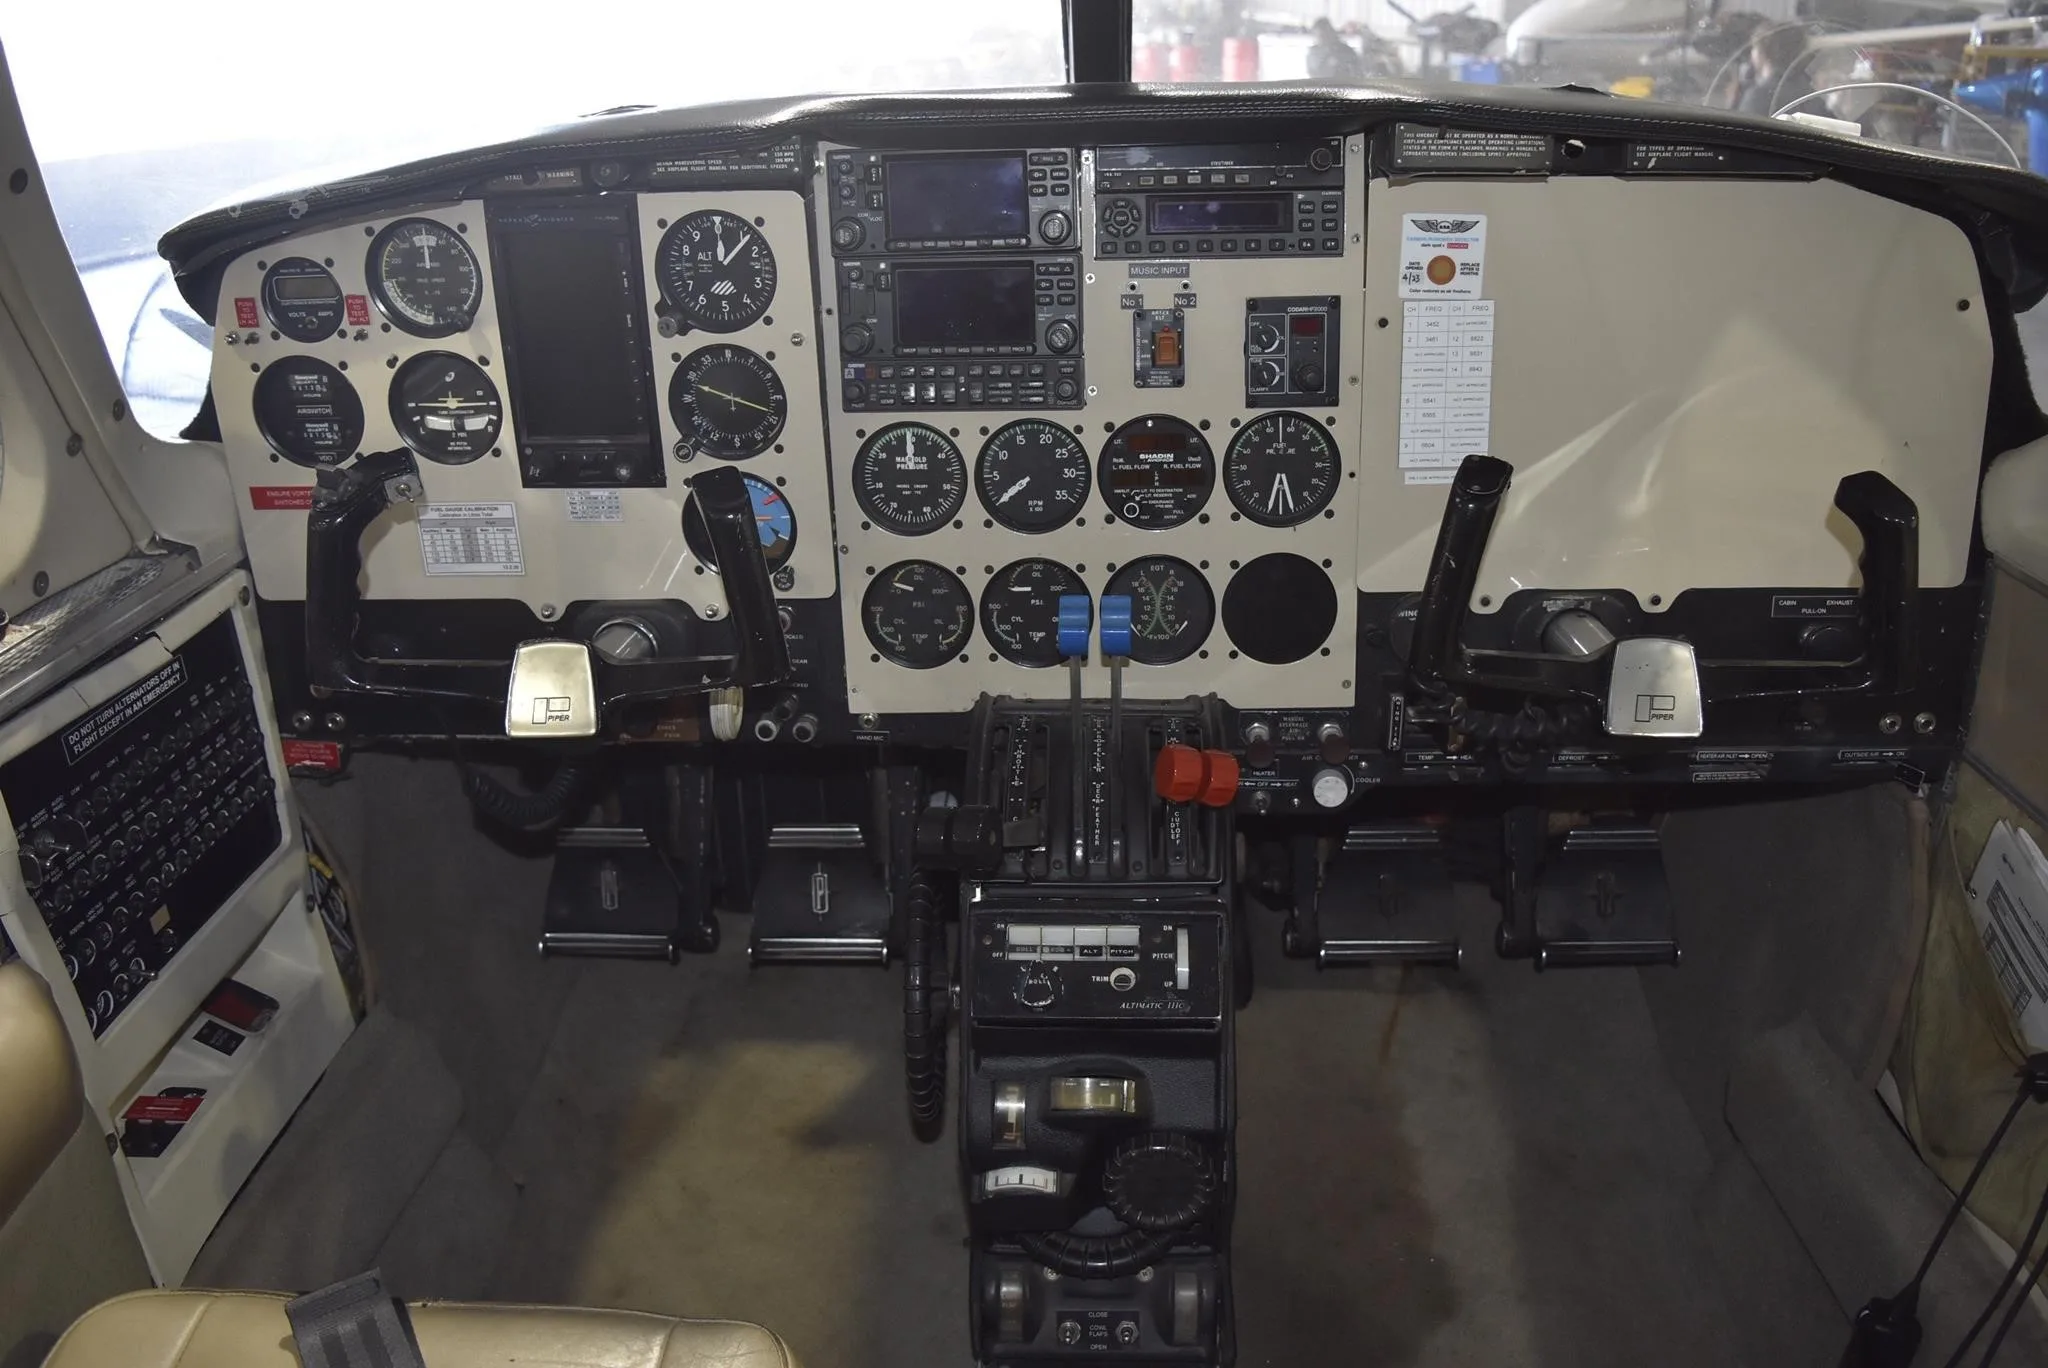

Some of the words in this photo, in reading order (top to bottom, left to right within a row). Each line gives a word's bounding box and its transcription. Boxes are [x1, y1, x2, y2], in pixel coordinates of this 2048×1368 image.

[693, 231, 700, 242] 9
[682, 245, 690, 255] 8
[752, 247, 759, 257] 2
[698, 251, 713, 261] ALT
[1161, 266, 1187, 274] INPUT
[687, 280, 693, 291] 7
[754, 278, 762, 288] 3
[699, 294, 706, 304] 6
[743, 294, 751, 304] 4
[722, 301, 730, 311] 5
[767, 416, 778, 424] 12
[754, 432, 764, 440] 15
[1016, 436, 1026, 444] 15
[1040, 435, 1052, 444] 20
[999, 452, 1008, 460] 10
[1056, 449, 1068, 458] 25
[993, 472, 999, 480] 5
[1063, 469, 1076, 478] 30
[1055, 491, 1068, 500] 35
[68, 733, 80, 745] DO
[81, 721, 95, 736] NOT
[96, 708, 113, 724] TURN
[115, 676, 160, 716] ALTERNATORS
[159, 667, 172, 680] OFF
[172, 662, 180, 672] IN
[74, 734, 98, 755] FLIGHT
[99, 714, 125, 738] EXCEPT
[125, 708, 134, 717] IN
[133, 701, 143, 712] AN
[143, 672, 181, 704] EMERGENCY
[1014, 745, 1024, 787] THROTTLE
